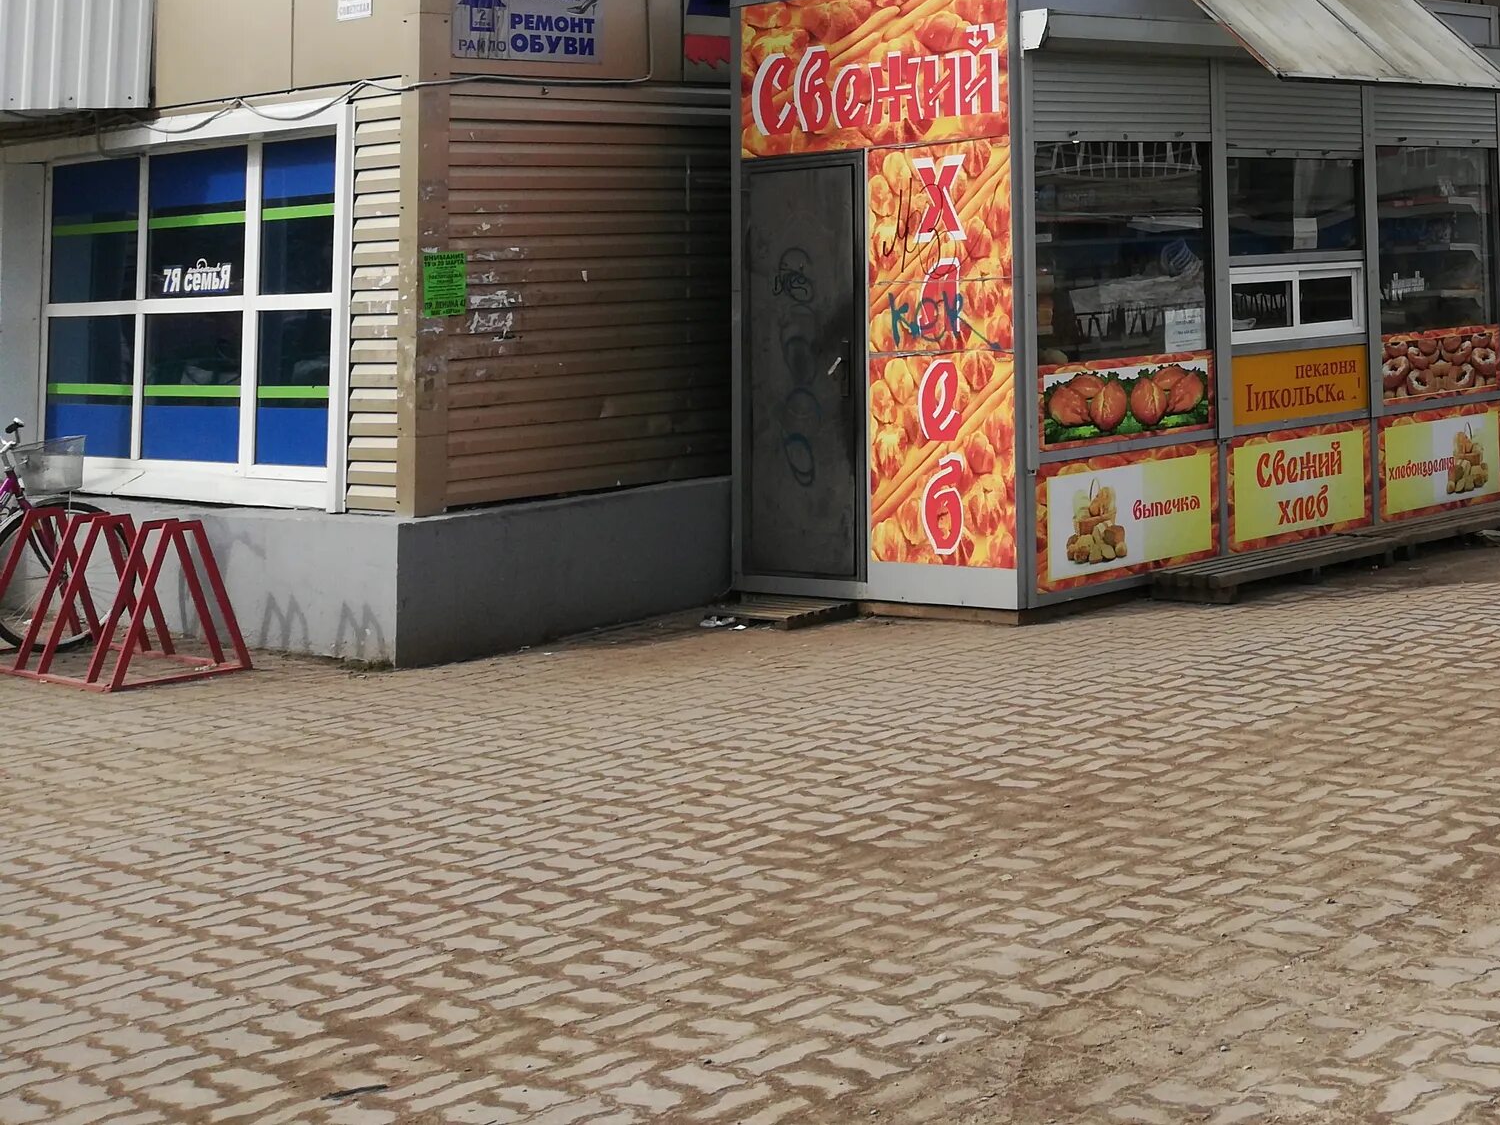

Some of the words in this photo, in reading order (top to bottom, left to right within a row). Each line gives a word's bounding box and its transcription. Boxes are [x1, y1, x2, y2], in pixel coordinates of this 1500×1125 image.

[479, 9, 487, 21] 2
[510, 13, 595, 34] РЕМОНТ
[510, 33, 595, 56] ОБУВИ
[752, 23, 1000, 135] Свежий
[163, 267, 182, 293] 7Я
[1256, 441, 1342, 488] Свежий
[1132, 495, 1201, 521] выпечка
[1278, 484, 1329, 525] хлеб
